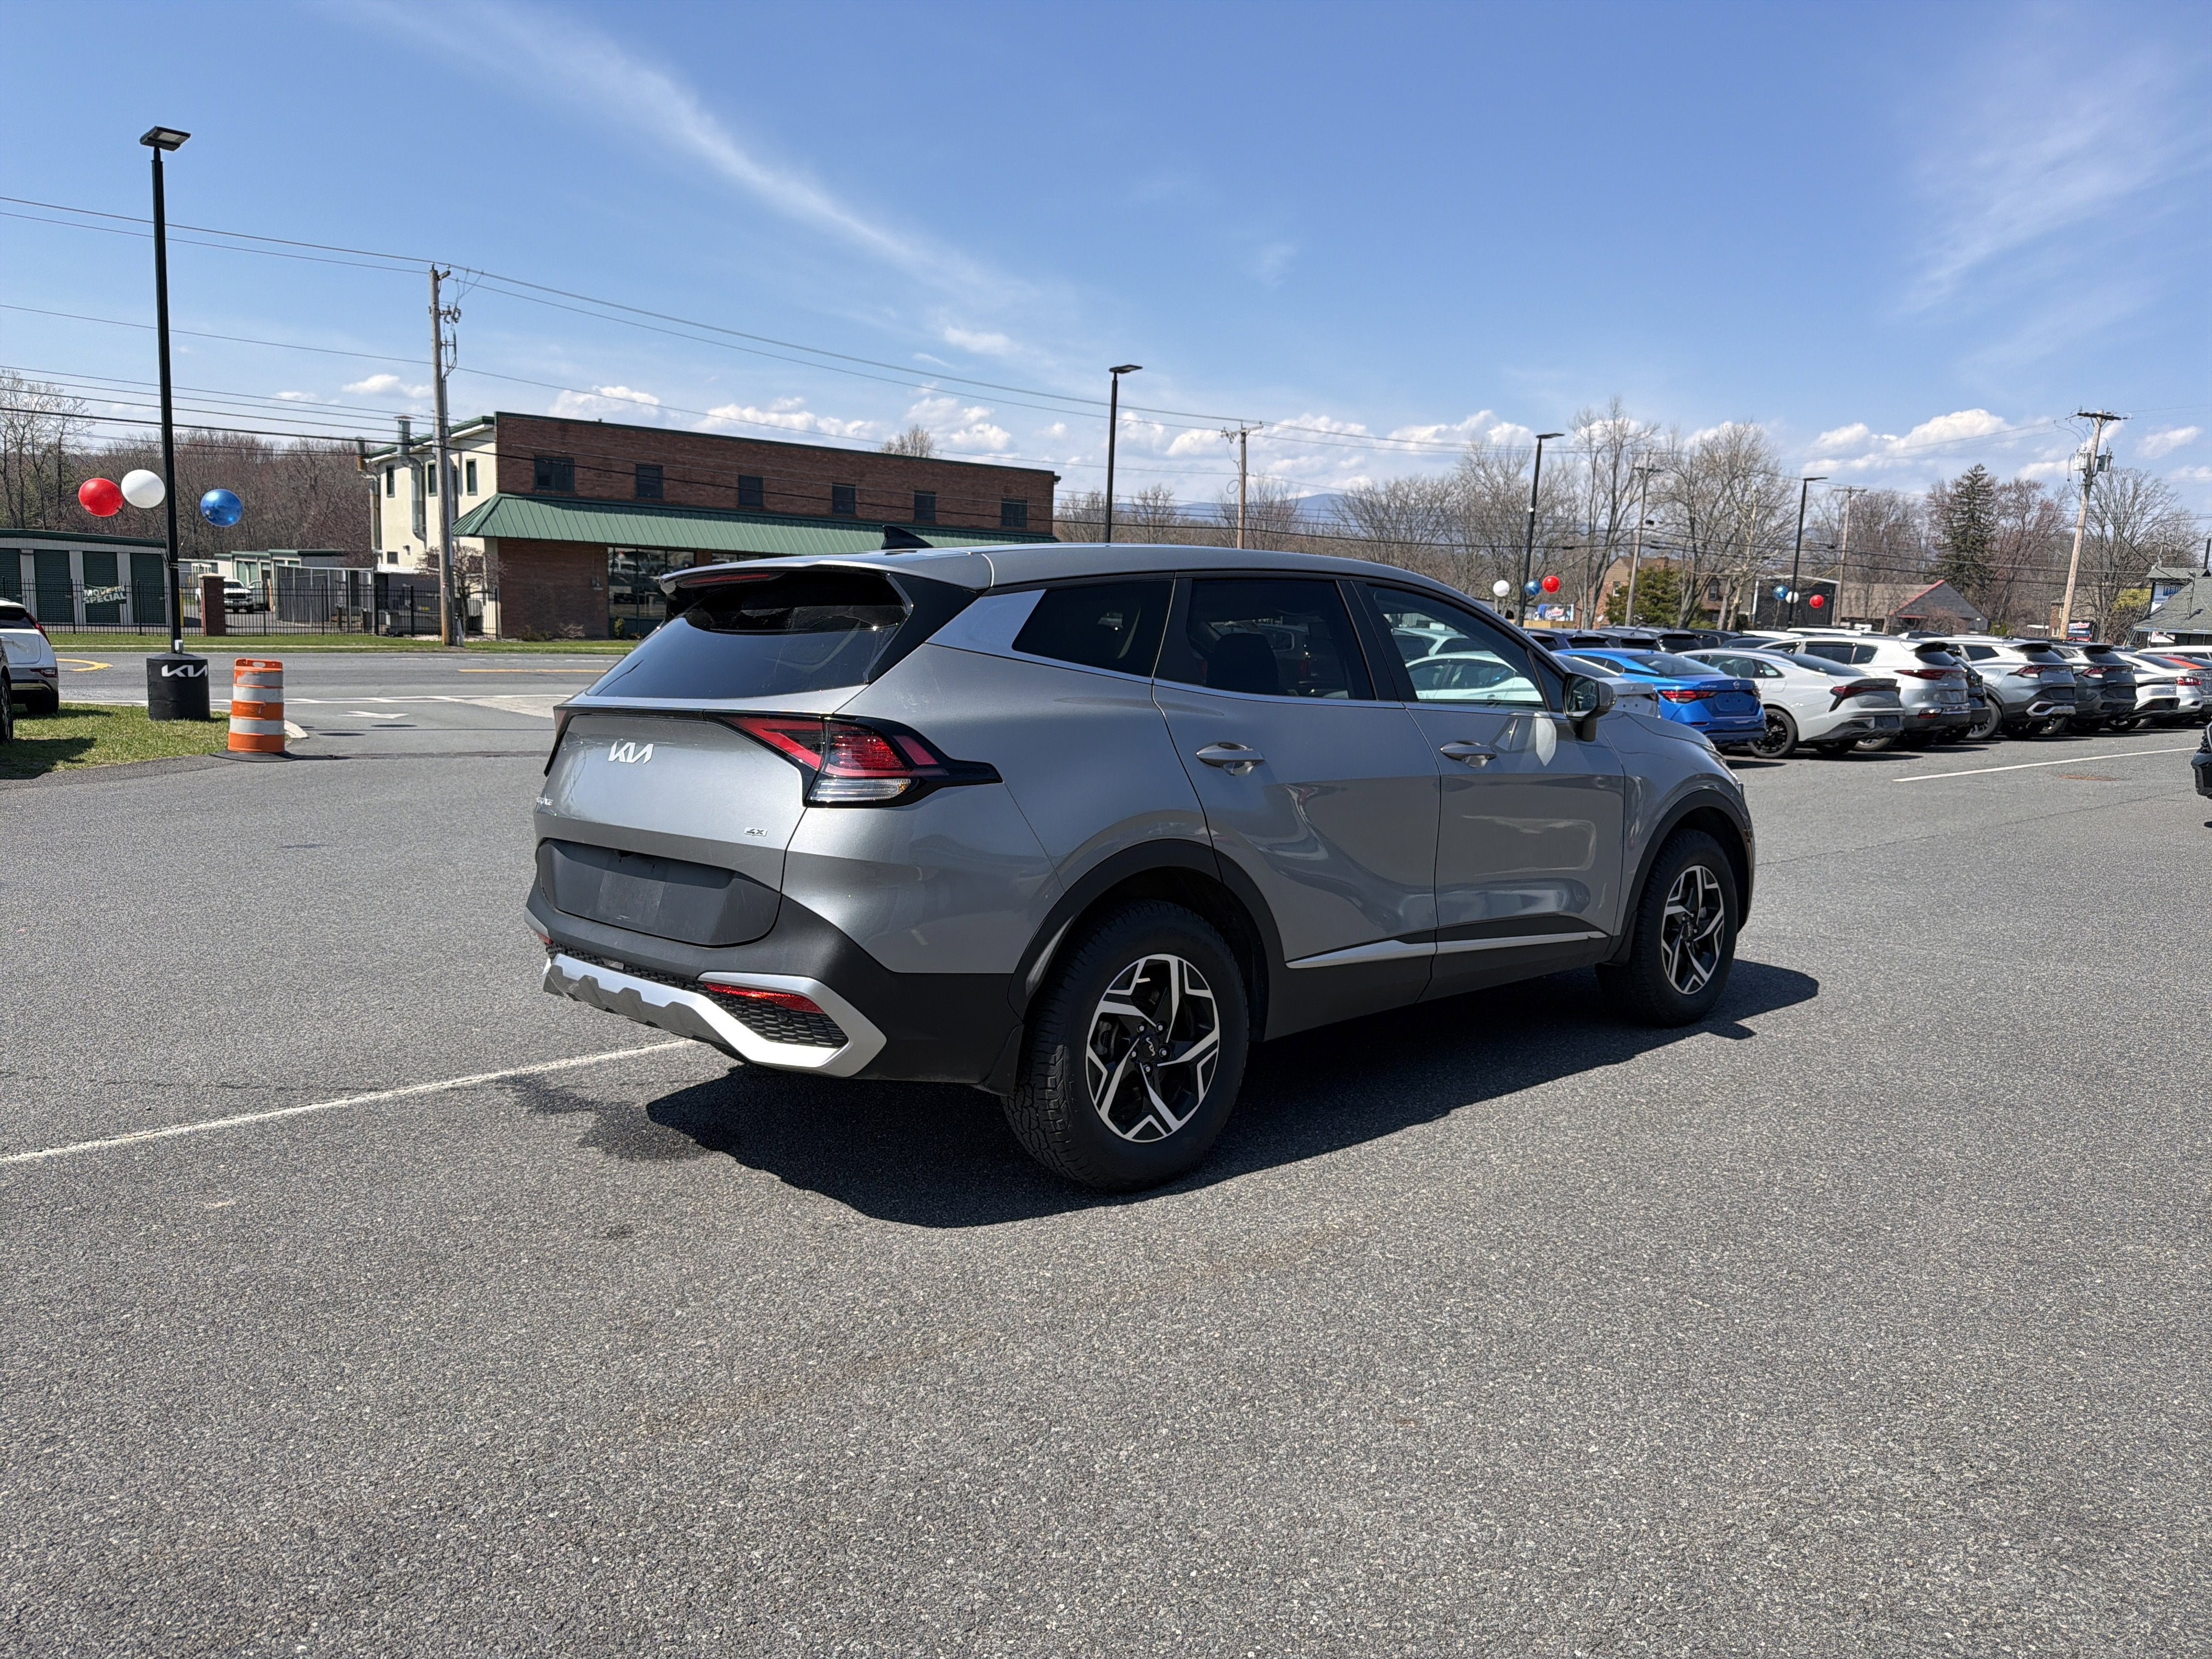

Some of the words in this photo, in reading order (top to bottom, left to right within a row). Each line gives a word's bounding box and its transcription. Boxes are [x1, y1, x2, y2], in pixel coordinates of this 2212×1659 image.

[83, 585, 126, 597] MOVE-IN
[83, 592, 127, 603] SPECIAL
[161, 664, 208, 678] KIA
[608, 741, 654, 764] KIA
